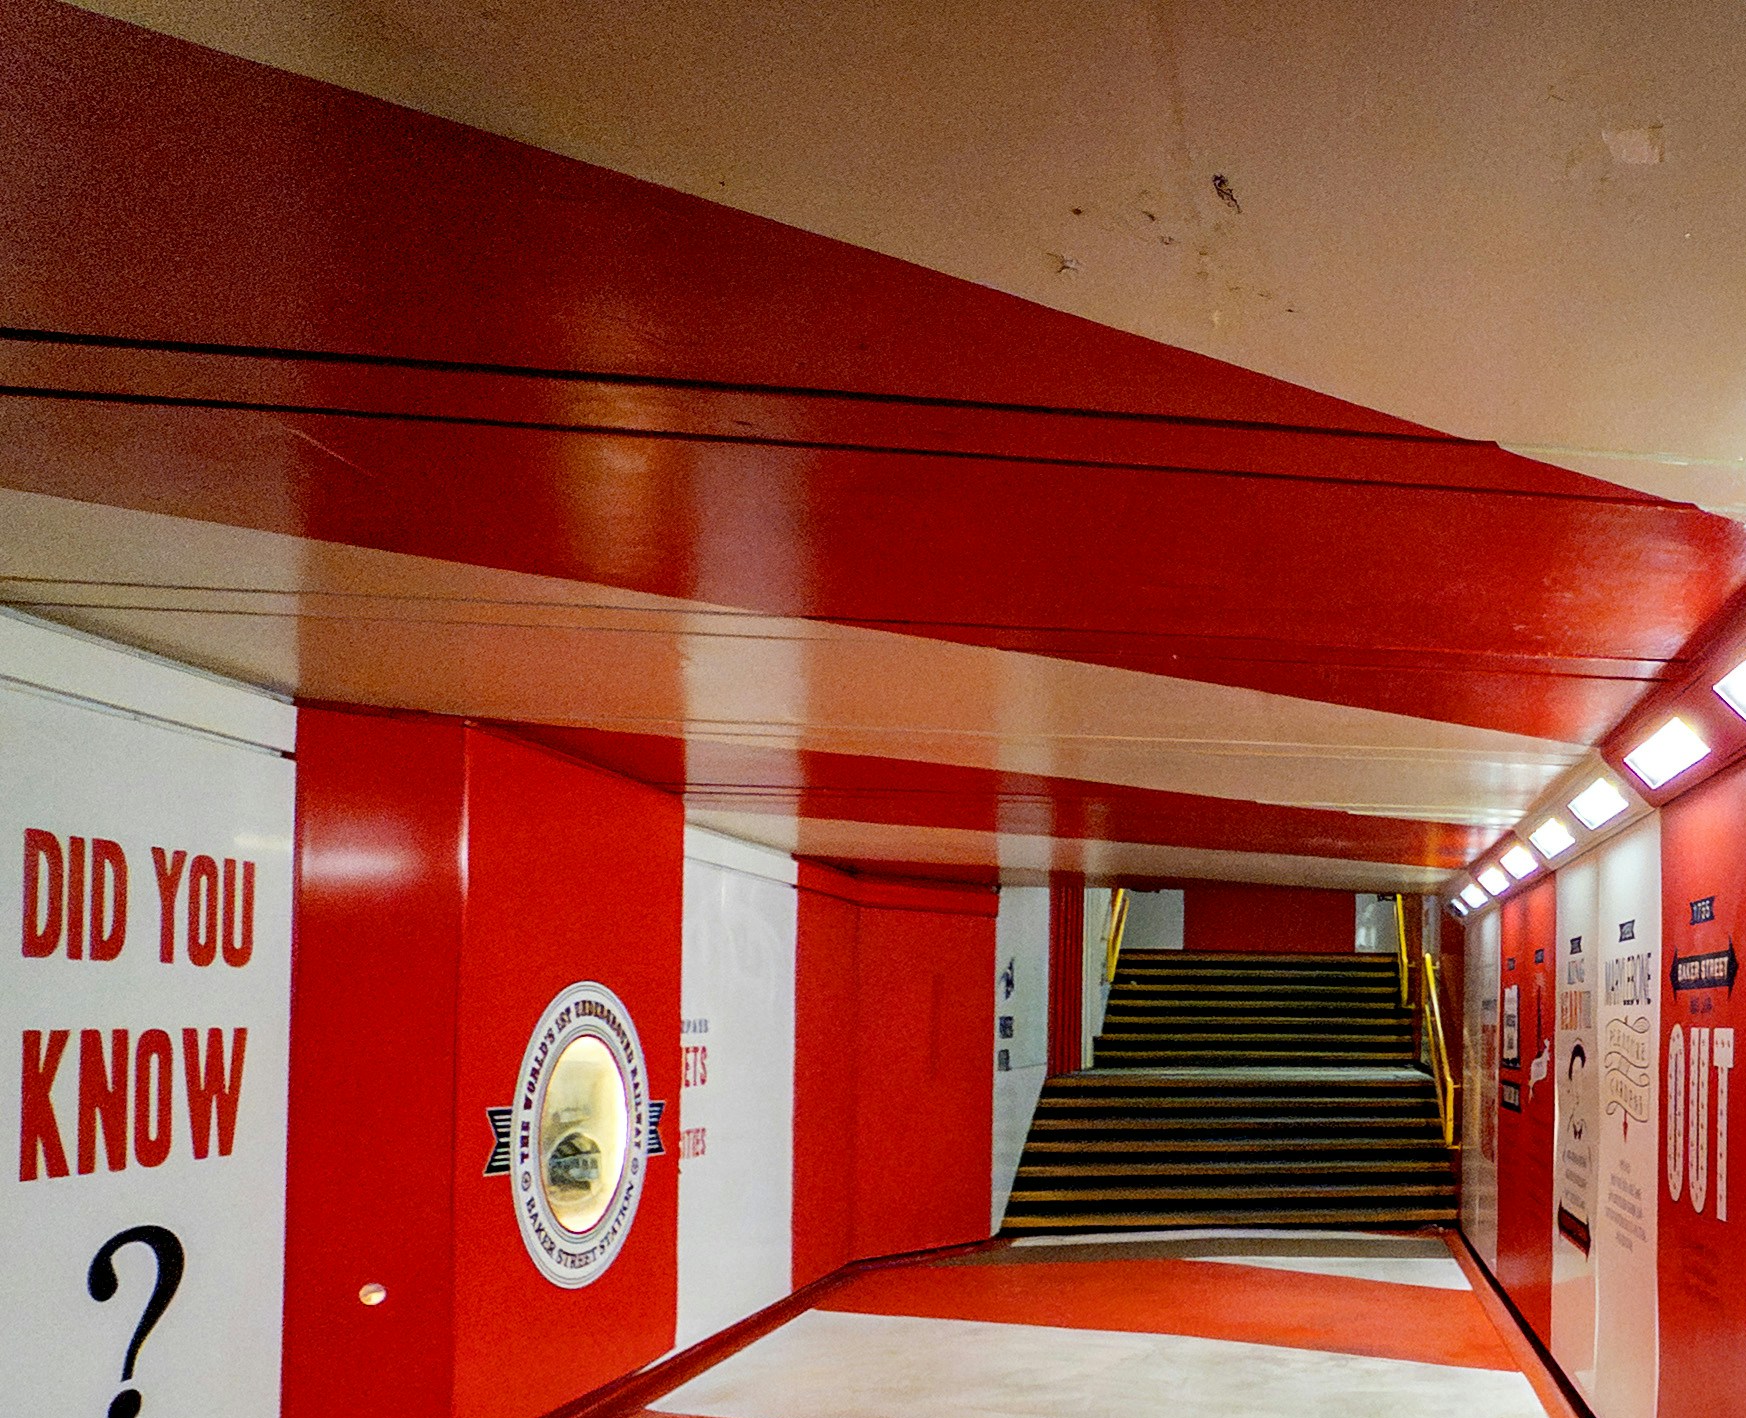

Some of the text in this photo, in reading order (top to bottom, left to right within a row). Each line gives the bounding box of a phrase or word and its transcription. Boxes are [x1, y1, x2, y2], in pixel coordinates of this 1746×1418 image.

[22, 828, 255, 968] DID YOU
[1678, 956, 1728, 982] BAKER STREET
[19, 1027, 248, 1182] KNOW
[519, 1120, 531, 1165] THE
[631, 1065, 643, 1151] RAILWAY
[1667, 1023, 1735, 1221] OUT
[526, 1182, 635, 1269] BAKER STREET STATION
